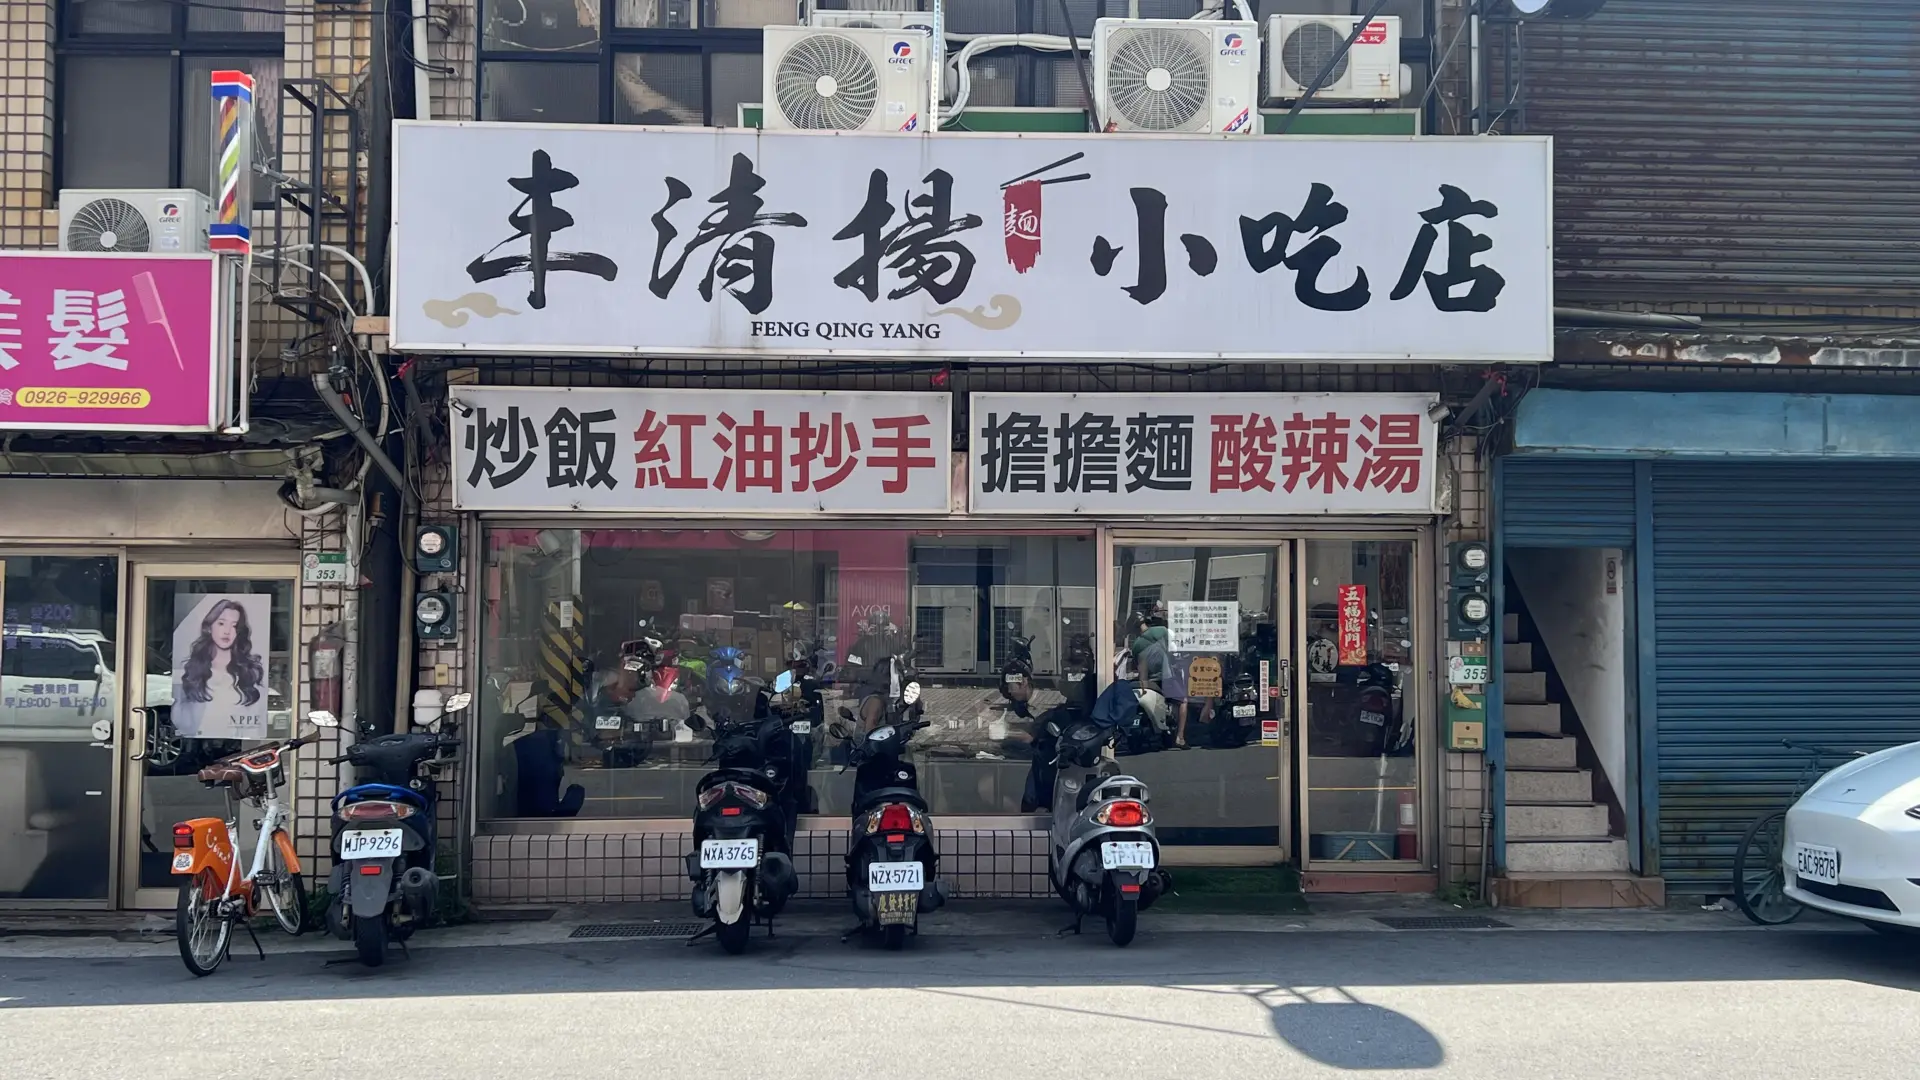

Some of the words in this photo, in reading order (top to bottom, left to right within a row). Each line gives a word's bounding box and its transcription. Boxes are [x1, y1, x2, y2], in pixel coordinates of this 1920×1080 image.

[888, 57, 915, 65] GREE
[1090, 183, 1505, 313] 小吃店
[0, 287, 130, 371] 髮
[751, 322, 809, 337] FENG
[816, 323, 874, 340] QING
[880, 323, 941, 339] YANG
[24, 390, 142, 405] 0926-929966
[465, 406, 618, 490] 炒飯
[634, 409, 936, 494] 紅油抄手
[981, 412, 1195, 494] 擔擔麵
[1210, 413, 1424, 494] 酸辣湯
[316, 569, 336, 580] 353
[1343, 586, 1362, 648] 五福臨門
[1464, 668, 1488, 680] 355
[228, 715, 261, 725] NPPE
[703, 846, 755, 861] NXA-3765
[871, 868, 920, 884] NZX-5721
